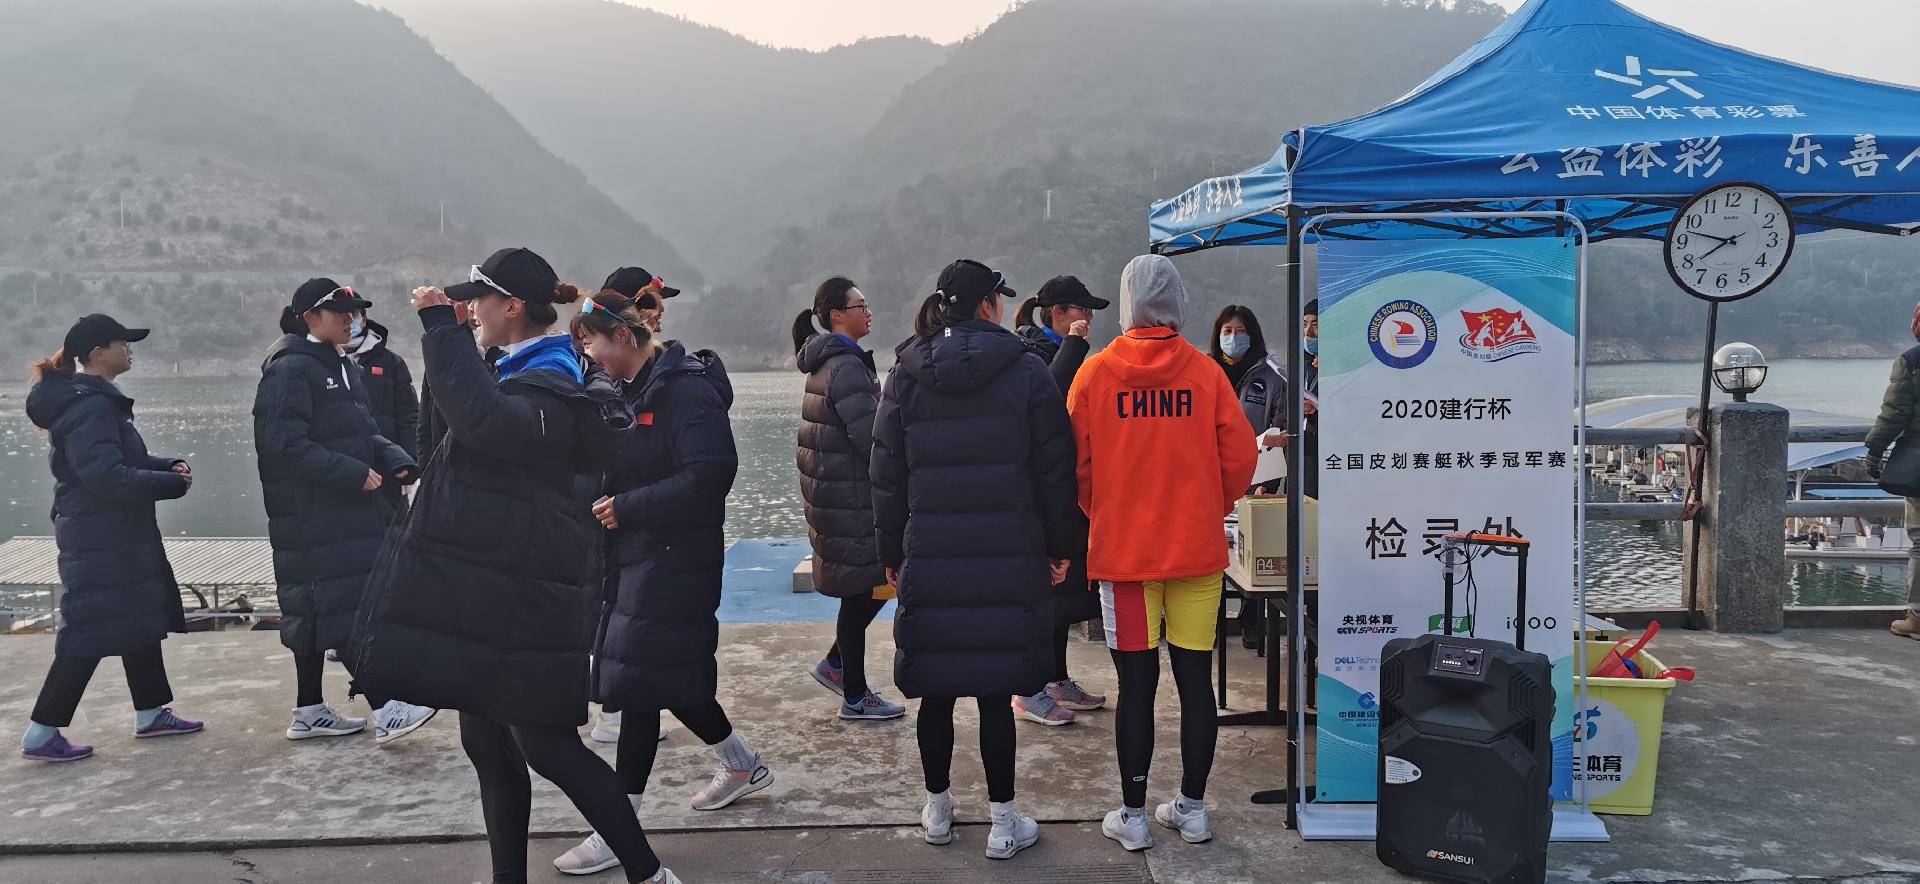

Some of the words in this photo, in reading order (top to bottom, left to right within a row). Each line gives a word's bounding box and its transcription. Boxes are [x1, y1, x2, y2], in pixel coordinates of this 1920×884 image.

[1567, 105, 1807, 120] 中国体育彩票
[1704, 198, 1717, 214] 11
[1724, 192, 1742, 208] 12
[1753, 198, 1758, 214] 1
[1685, 214, 1703, 230] 10
[1762, 213, 1775, 229] 2
[1676, 233, 1688, 250] 9
[1765, 231, 1779, 248] 3
[1681, 254, 1694, 269] 8
[1755, 252, 1767, 267] 4
[1695, 268, 1708, 285] 7
[1715, 273, 1728, 288] 6
[1738, 267, 1751, 283] 5
[1370, 312, 1385, 342] CHINESE
[1381, 302, 1409, 326] ROWING
[1409, 303, 1437, 342] ASSOCIATION
[1117, 389, 1192, 418] CHINA
[1381, 397, 1512, 420] 2020建行杯
[1325, 450, 1567, 470] 全国皮划赛艇秋季冠军赛
[1256, 558, 1274, 570] A4
[1342, 614, 1393, 626] 央视体育
[1337, 627, 1357, 635] CCTV
[1357, 626, 1398, 634] SPORTS
[1437, 851, 1475, 865] SANSUI
